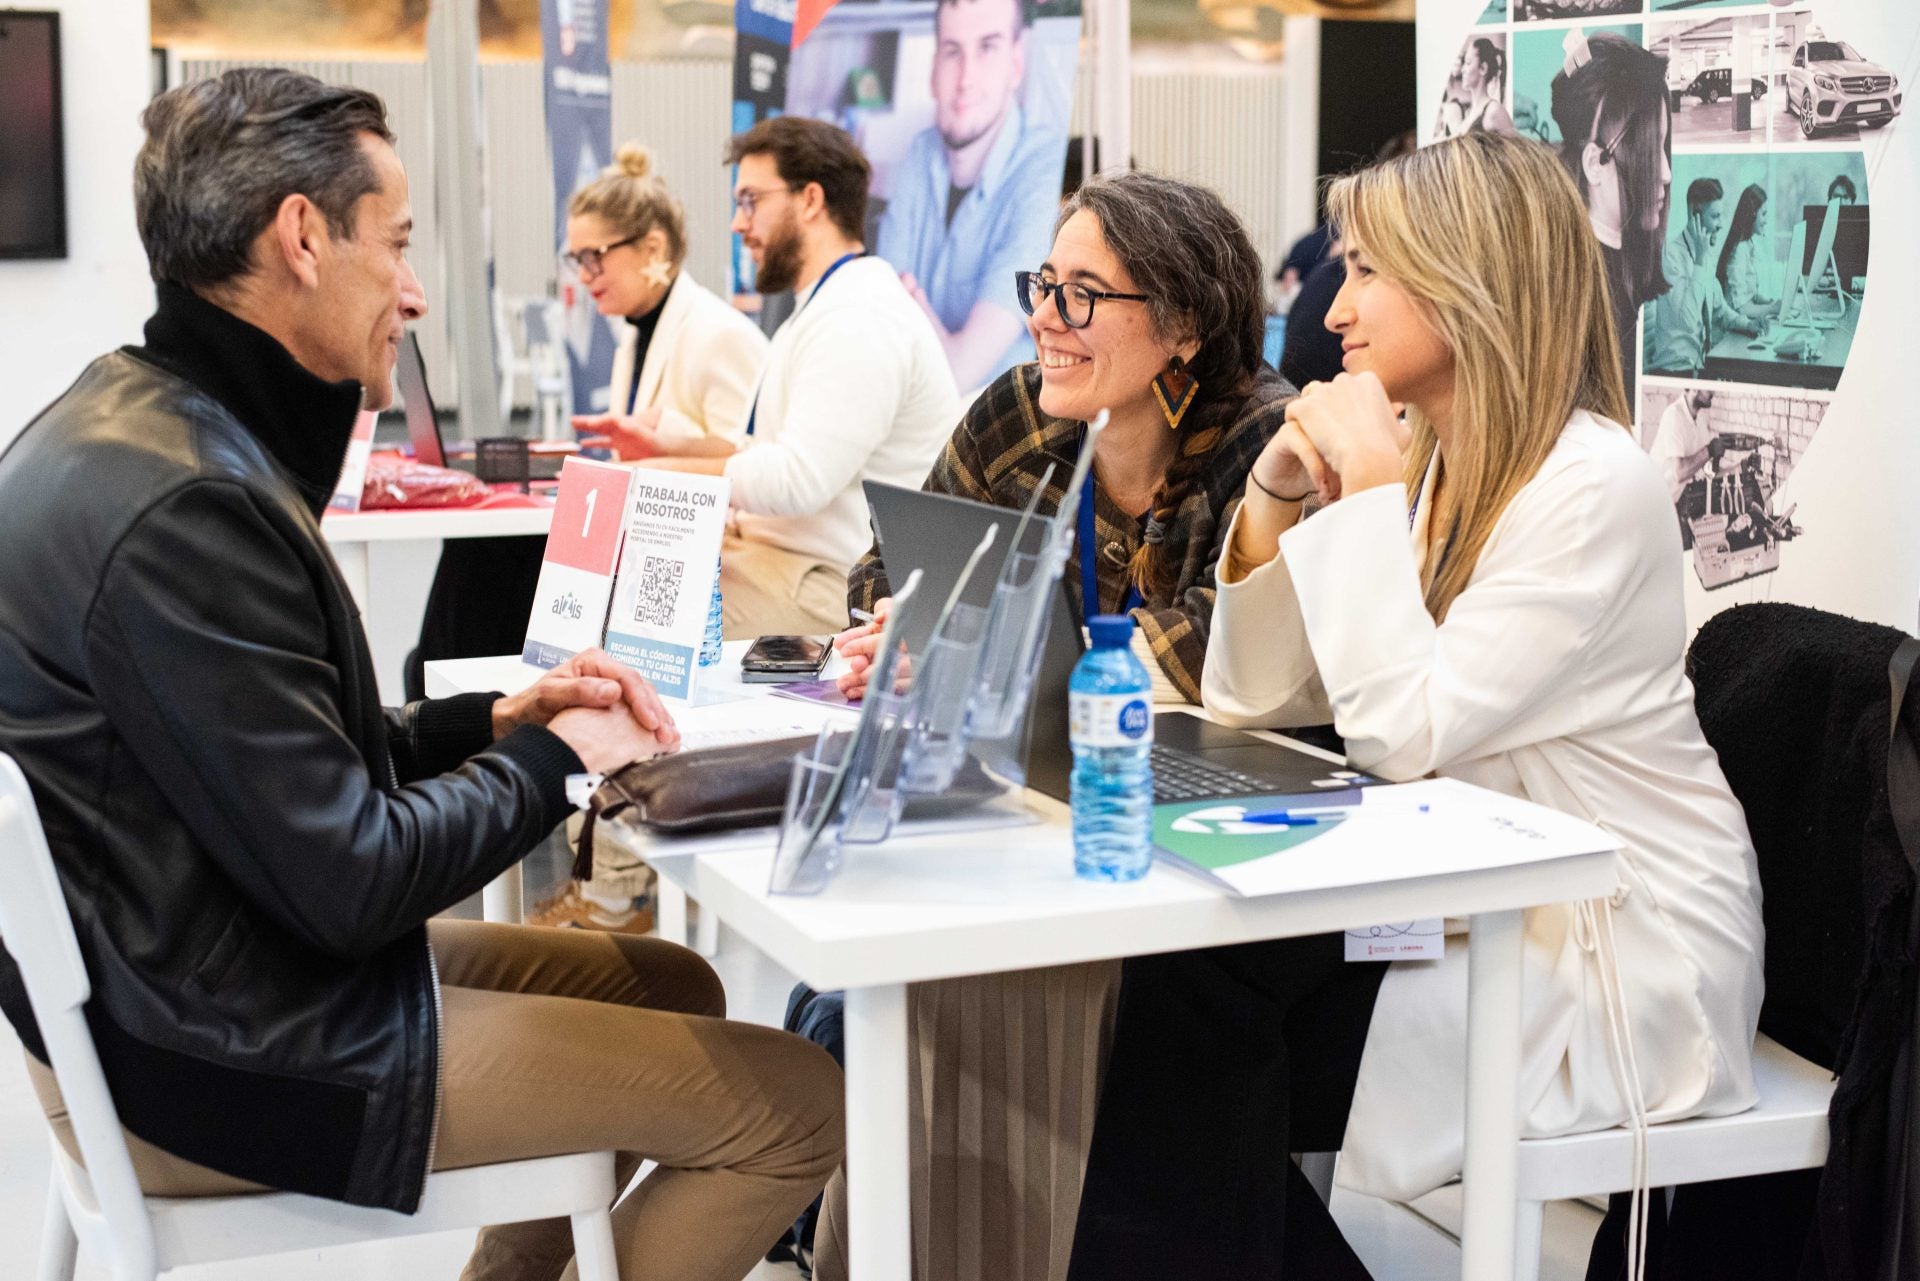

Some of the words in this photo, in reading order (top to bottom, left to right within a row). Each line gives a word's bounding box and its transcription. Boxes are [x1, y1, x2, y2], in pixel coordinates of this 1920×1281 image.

[639, 485, 688, 504] TRABAJA
[692, 492, 717, 508] CON
[581, 487, 598, 538] 1
[635, 501, 696, 521] NOSOTROS
[610, 642, 640, 656] ESCANEA
[640, 649, 648, 657] EL
[649, 649, 675, 663] CÓDIGO
[612, 652, 644, 667] COMIENZA
[645, 660, 654, 669] TU
[655, 662, 686, 676] CARRERA
[651, 671, 661, 680] EN
[661, 673, 682, 686] ALZIS
